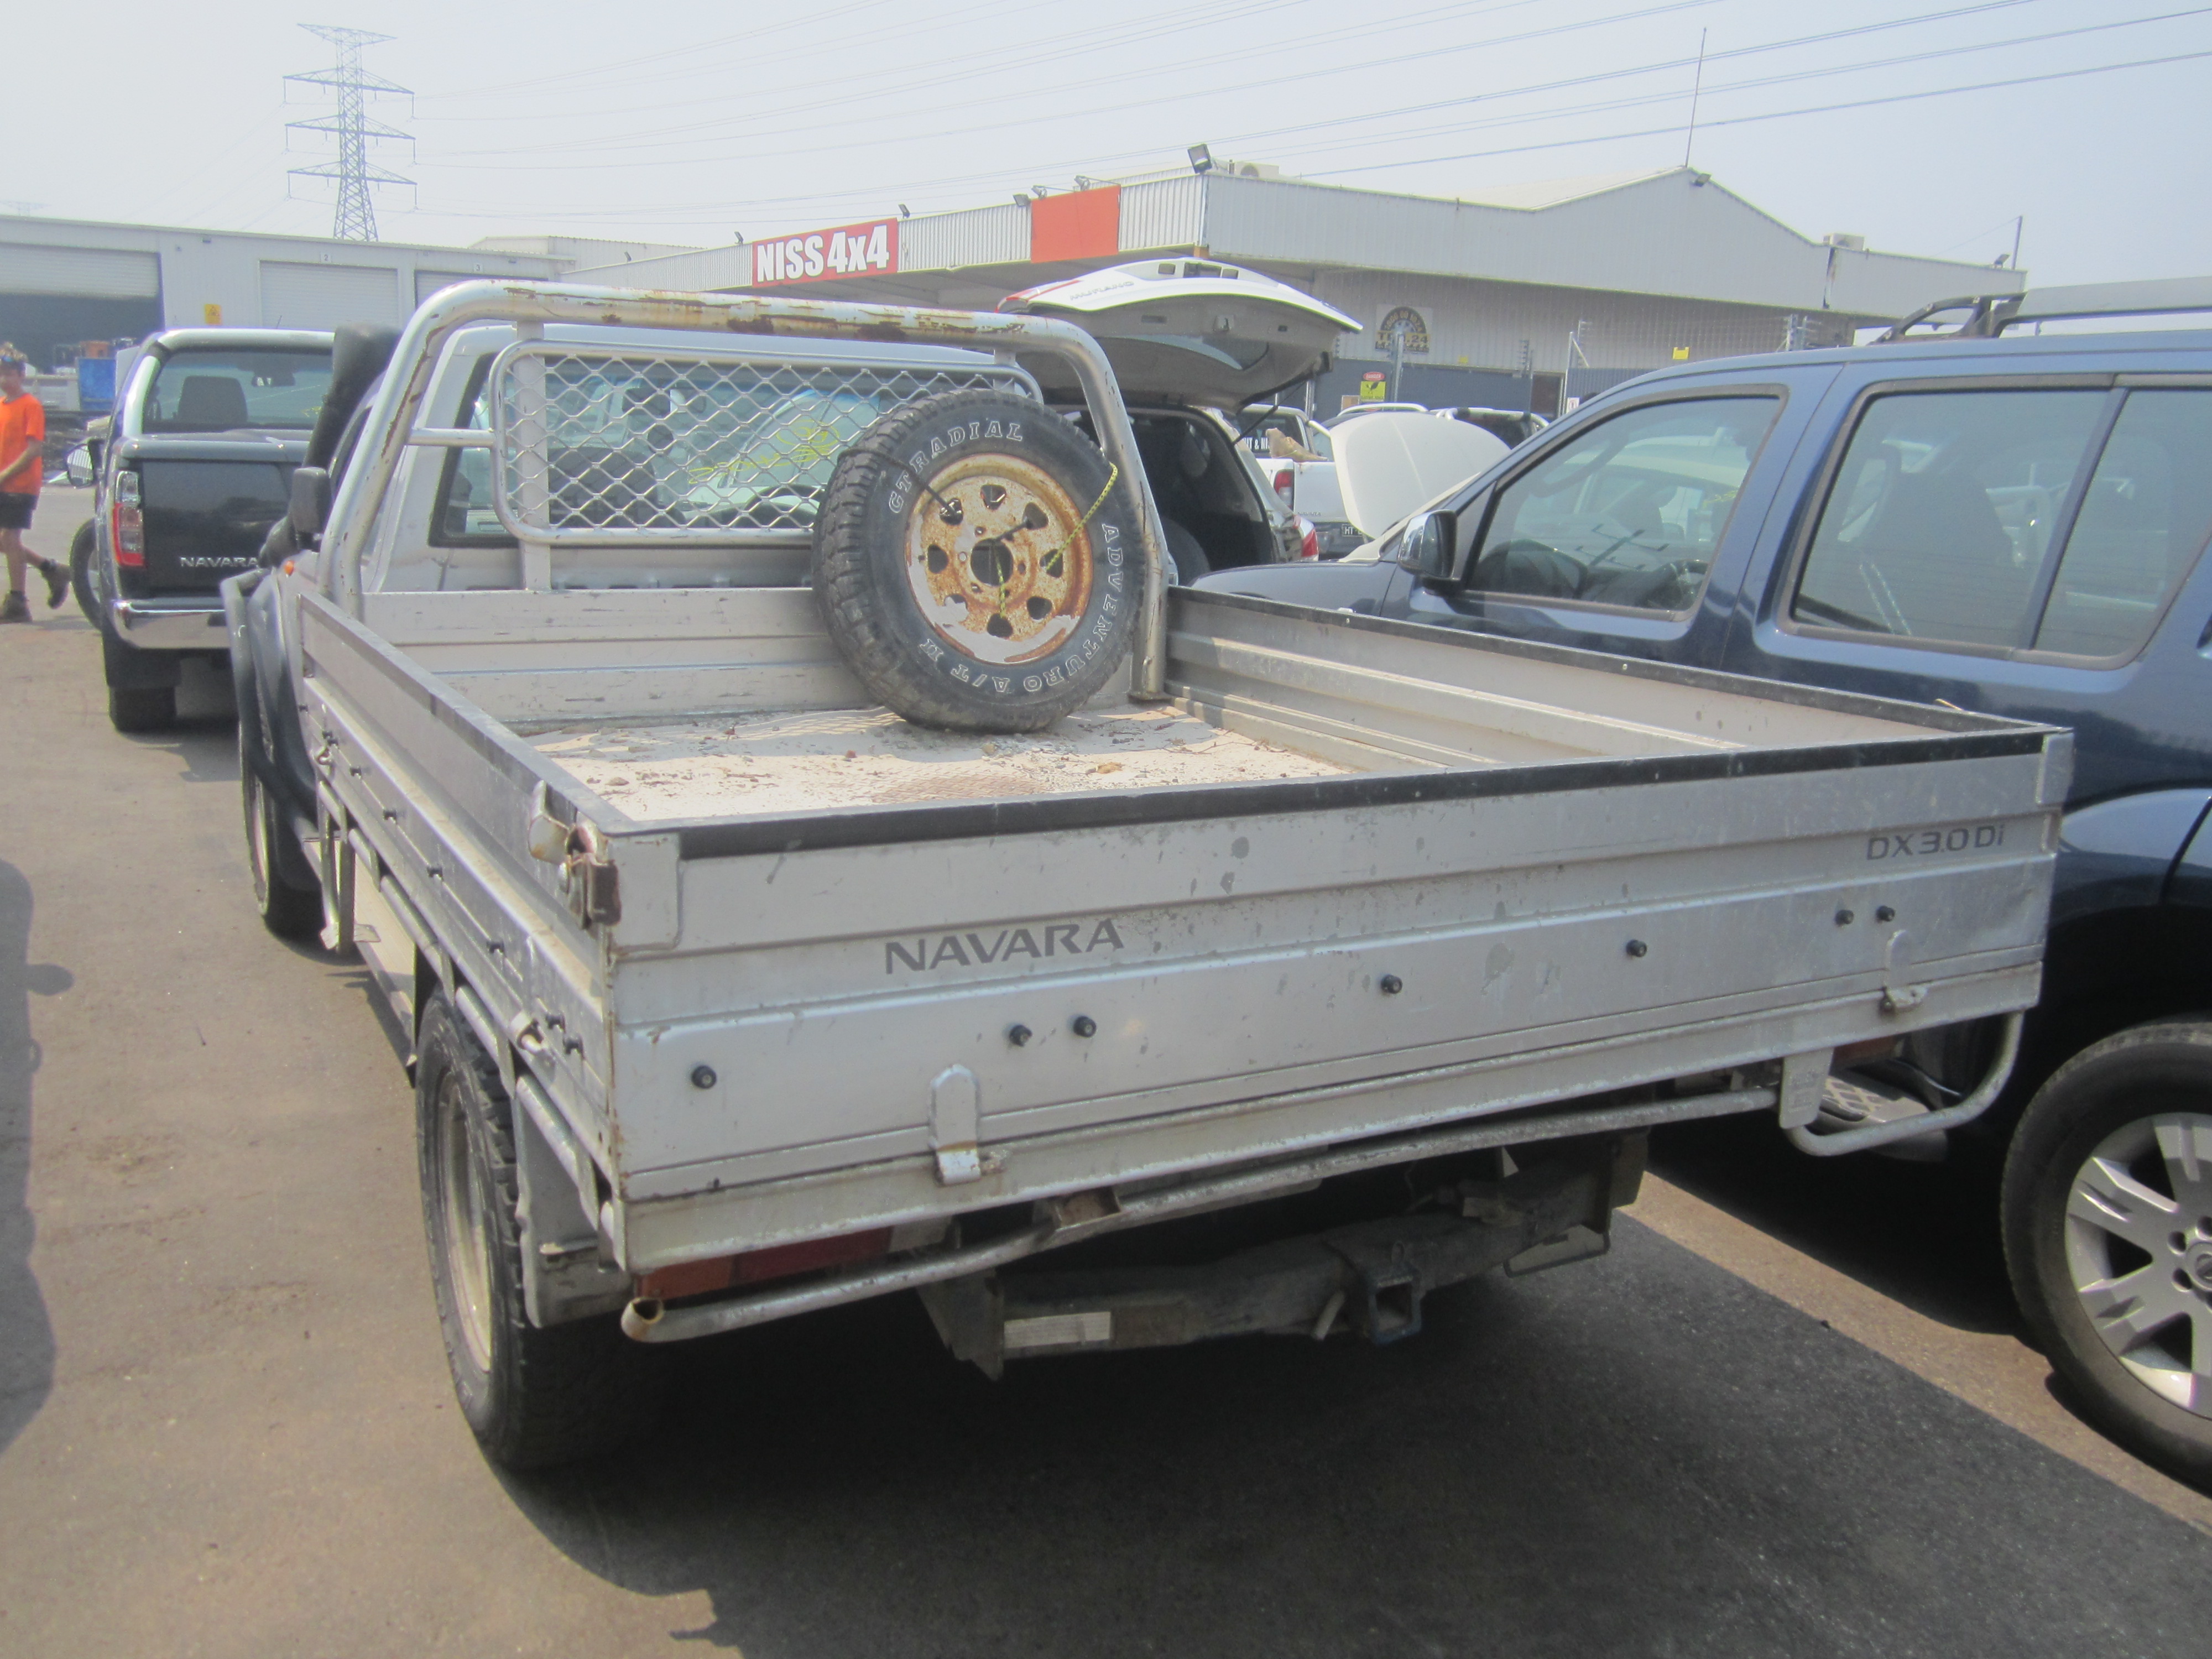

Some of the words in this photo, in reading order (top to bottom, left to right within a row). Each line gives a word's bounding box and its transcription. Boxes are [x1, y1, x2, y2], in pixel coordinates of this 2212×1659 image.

[888, 469, 912, 514] GT
[909, 420, 1022, 474] RADIAL
[1254, 439, 1260, 450] &
[1261, 437, 1270, 450] NI
[180, 556, 259, 568] NAVARA
[1023, 523, 1124, 692] ADVENTURO
[885, 918, 1124, 975] NAVARA
